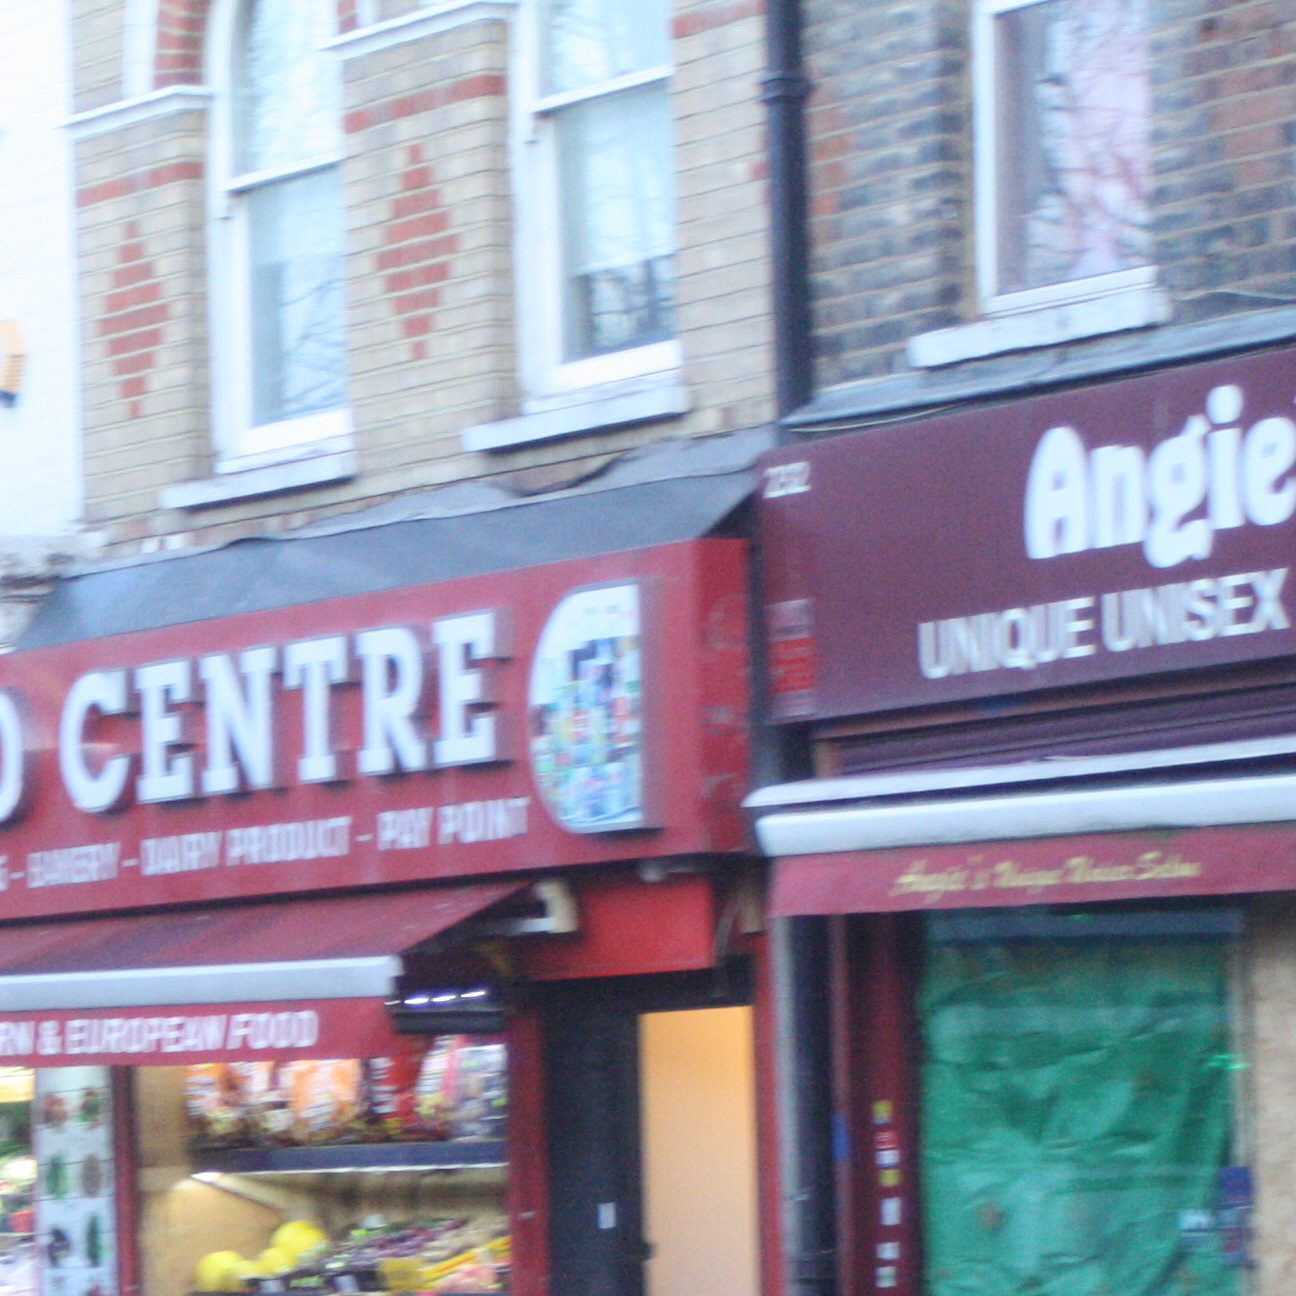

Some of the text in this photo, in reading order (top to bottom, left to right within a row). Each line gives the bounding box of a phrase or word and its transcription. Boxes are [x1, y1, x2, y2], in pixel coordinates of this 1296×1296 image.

[1023, 384, 1296, 569] Angie
[919, 567, 1290, 680] UNIQUE UNISEX
[59, 609, 498, 813] CENTRE
[225, 815, 353, 867] PRODUCT
[376, 806, 435, 851] PAY
[437, 796, 531, 846] POINT
[36, 1019, 64, 1056] &
[64, 1013, 228, 1056] EUROPEAN
[225, 1009, 320, 1052] FOOD
